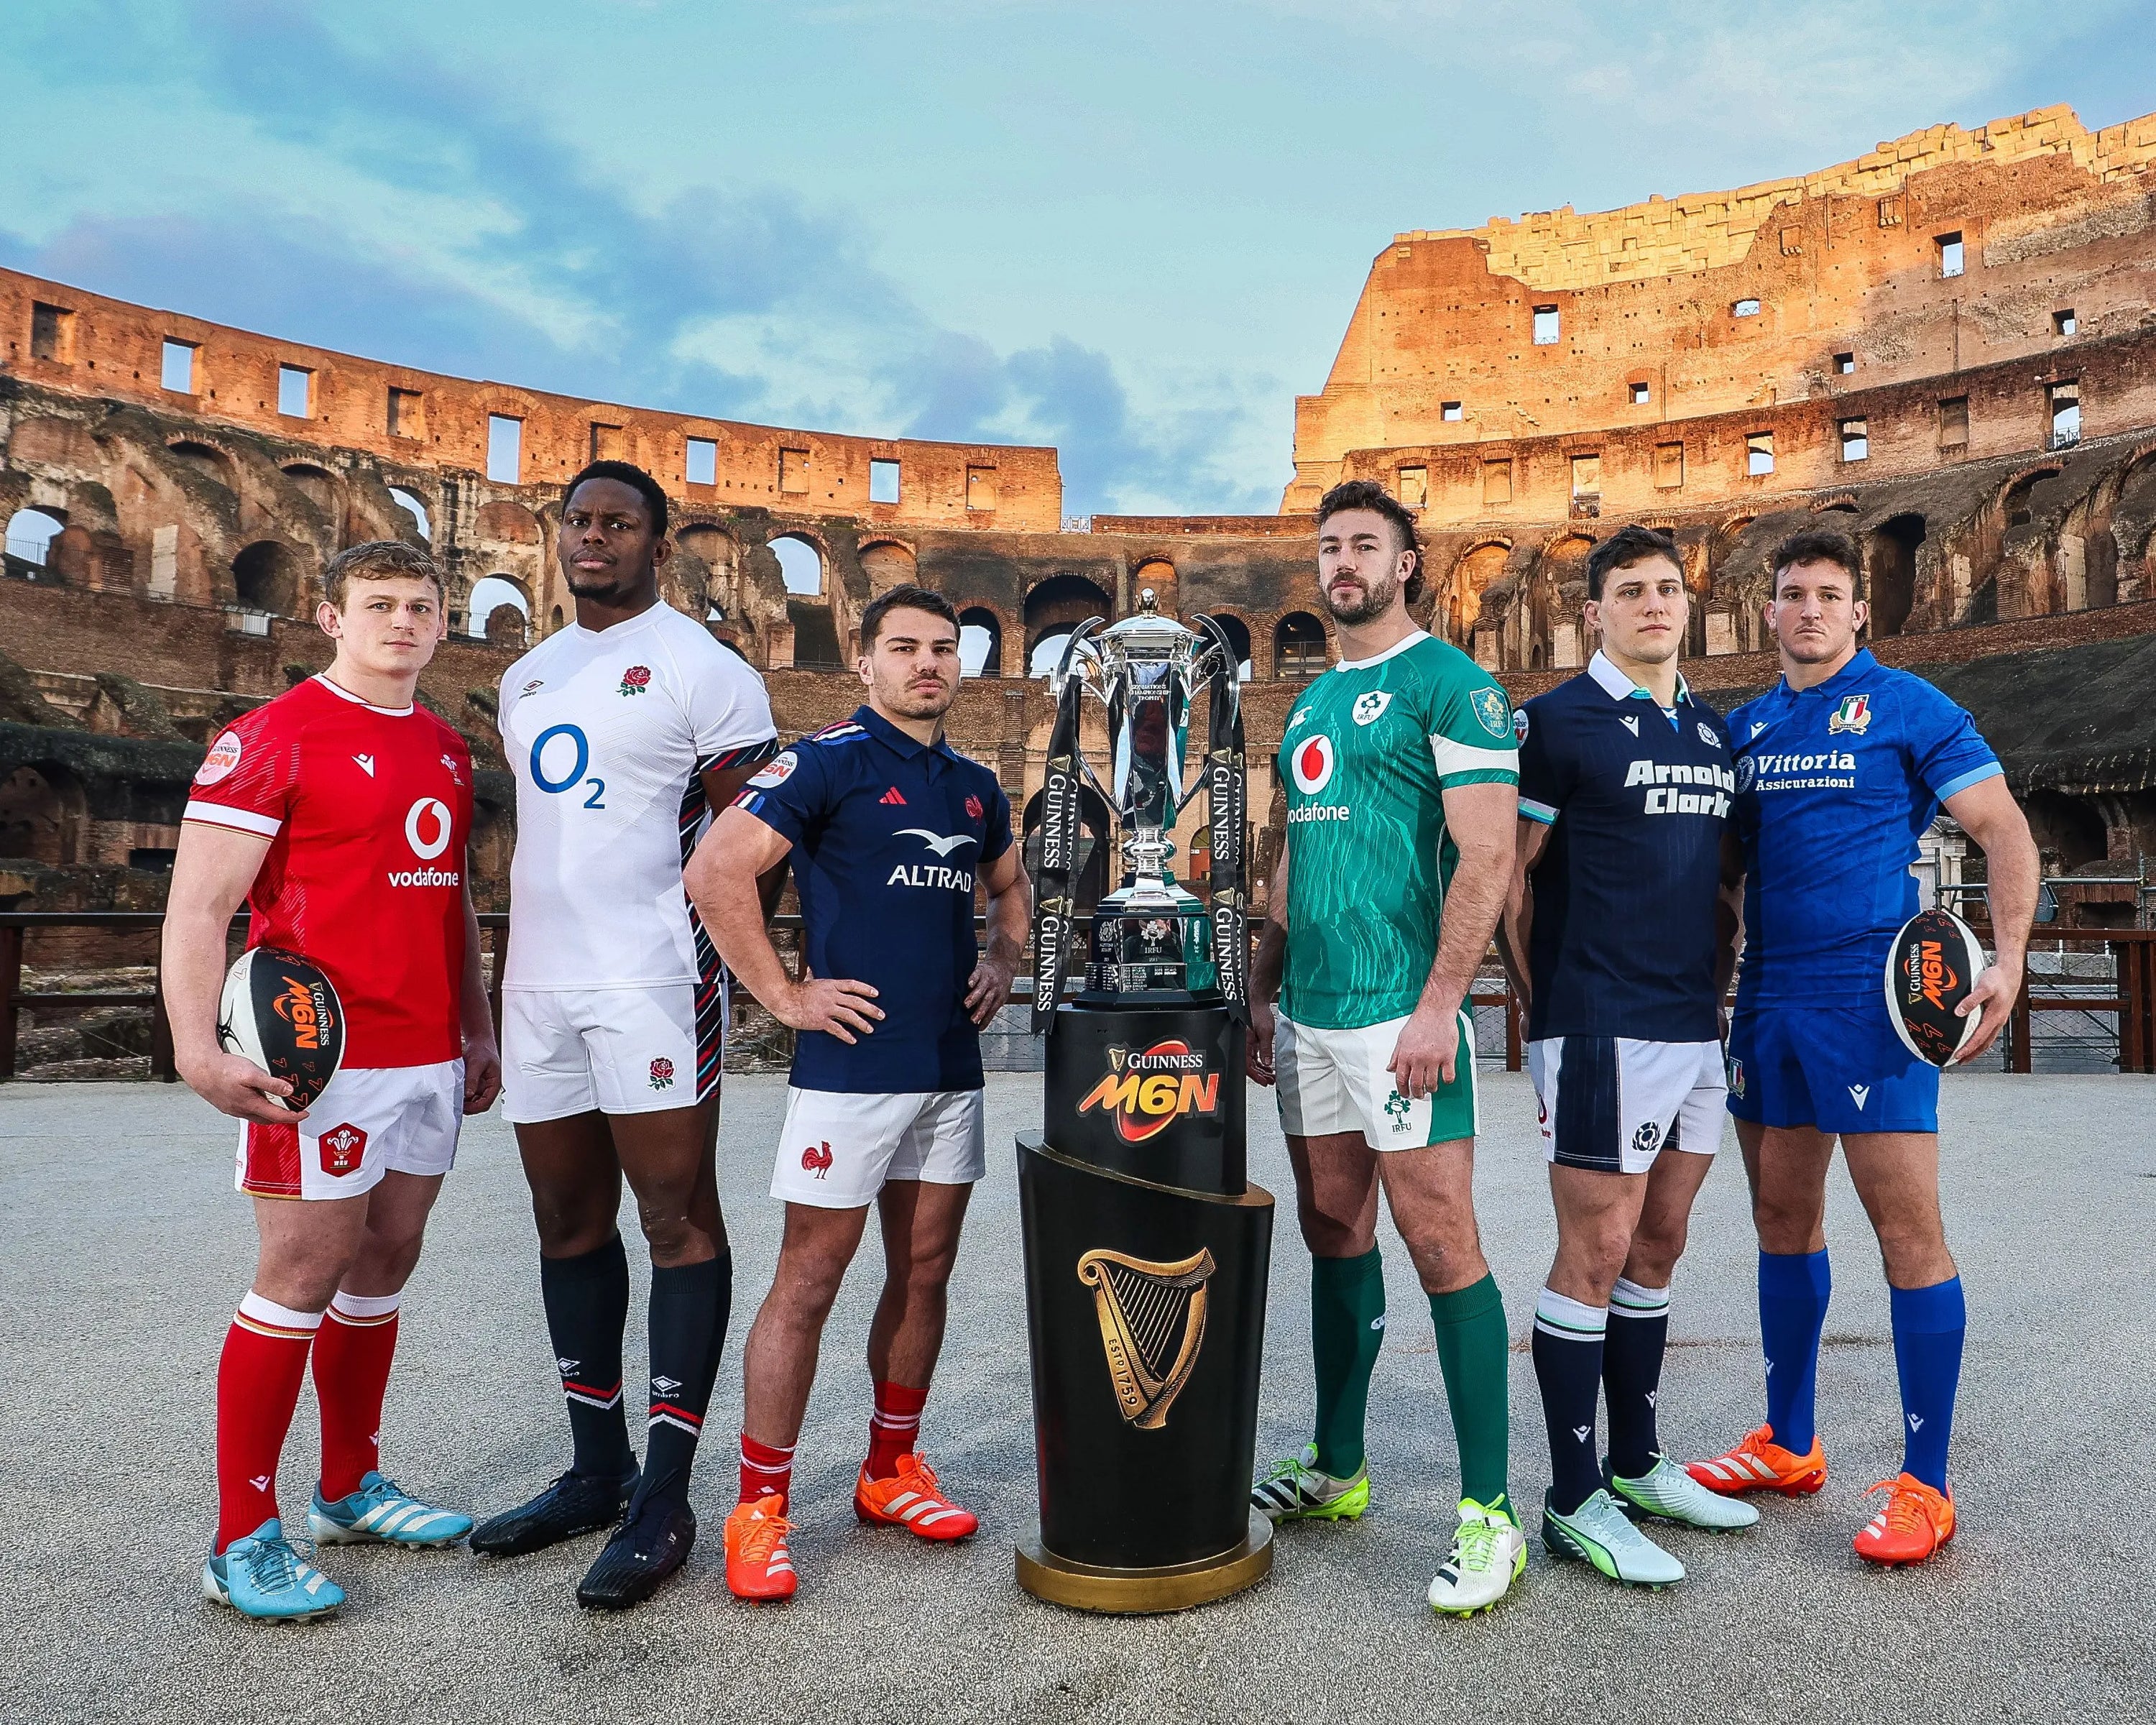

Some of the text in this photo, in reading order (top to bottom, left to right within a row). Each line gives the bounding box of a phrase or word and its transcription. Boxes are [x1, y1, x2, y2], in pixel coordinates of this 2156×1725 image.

[1623, 760, 1735, 794] Arnold
[1758, 750, 1856, 774] Vittoria
[1755, 776, 1855, 791] Assicurazioni
[1044, 773, 1067, 869] GUINNESS
[1213, 765, 1231, 861] GUINNESS
[1644, 788, 1731, 819] Clark
[388, 867, 459, 887] vodafone
[887, 865, 972, 893] ALTRAD
[1037, 916, 1060, 1011] GUINNESS
[1216, 907, 1238, 1000] GUINNESS
[1910, 944, 1921, 992] GUINNESS
[1922, 940, 1945, 1011] M6N
[282, 976, 318, 1049] M6N
[313, 992, 331, 1046] GUINNESS
[1128, 1053, 1203, 1070] GUINNESS
[1079, 1073, 1219, 1114] M6N
[1391, 1123, 1412, 1133] IRFU
[1116, 1370, 1138, 1406] 1759
